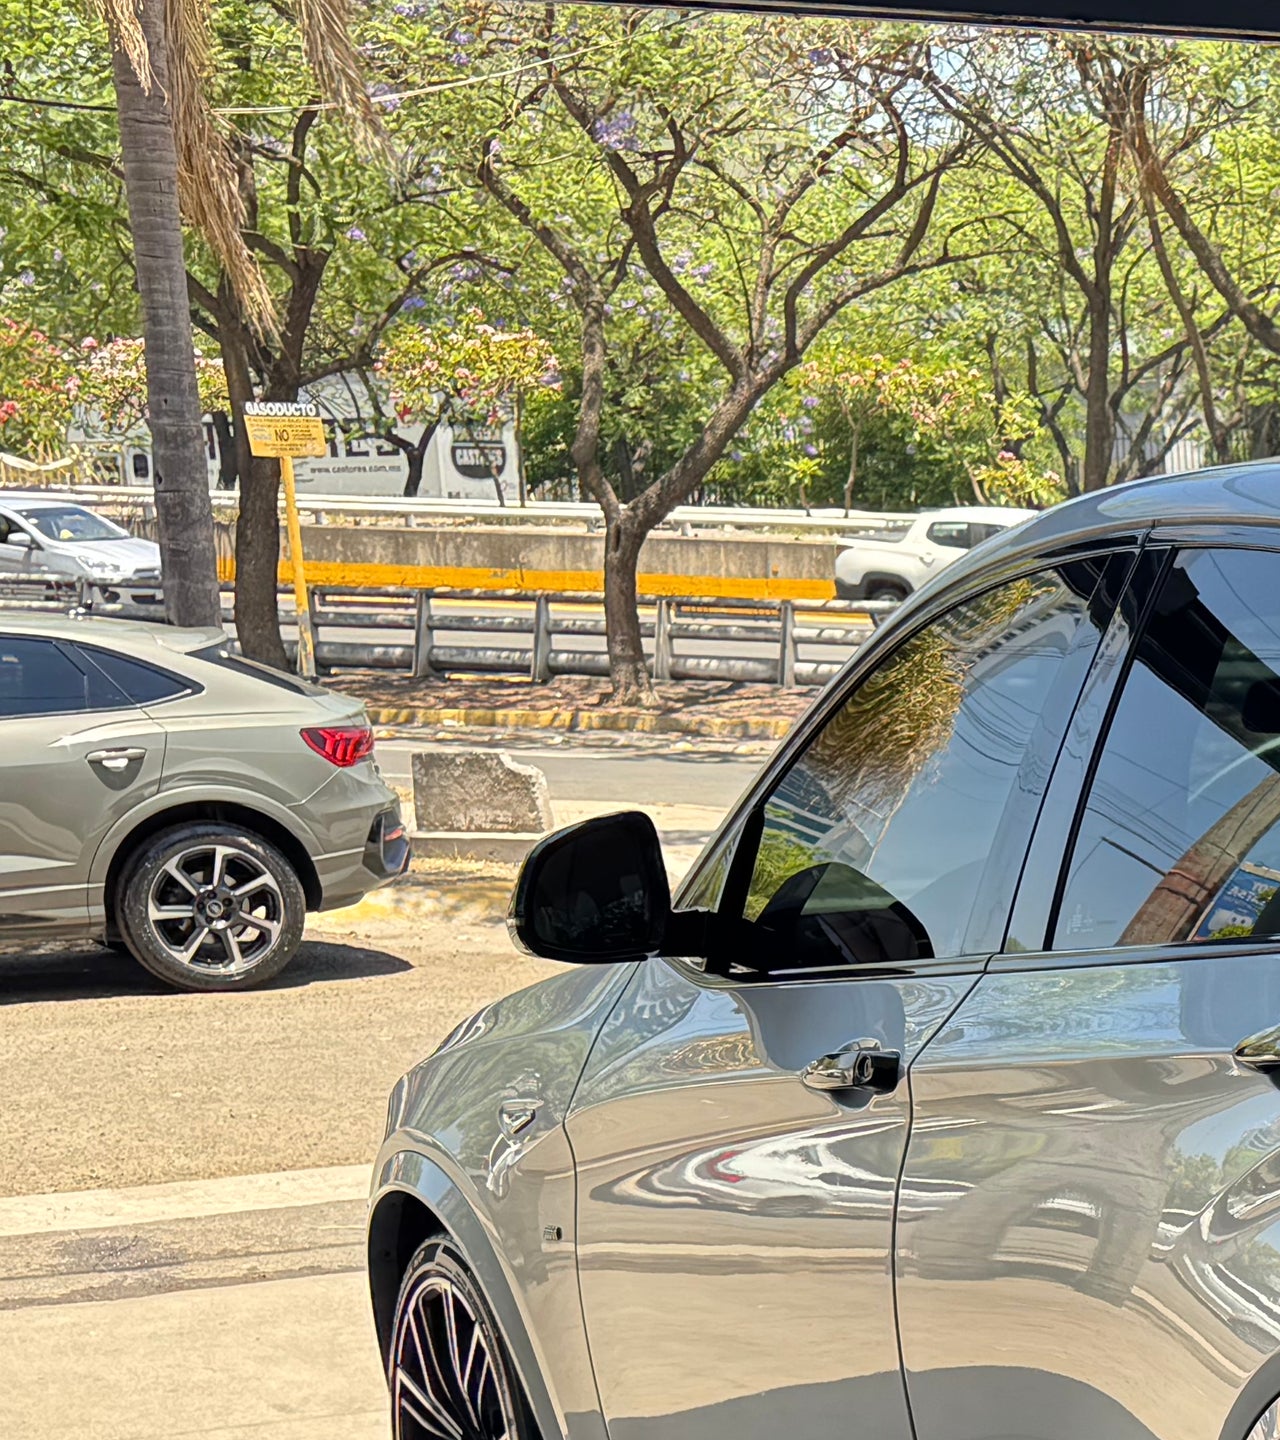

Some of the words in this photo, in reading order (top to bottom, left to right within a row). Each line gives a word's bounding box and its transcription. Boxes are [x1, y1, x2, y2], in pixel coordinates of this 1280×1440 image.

[245, 402, 316, 416] GASODUCTO
[274, 428, 290, 441] NO
[455, 448, 503, 466] CASTES
